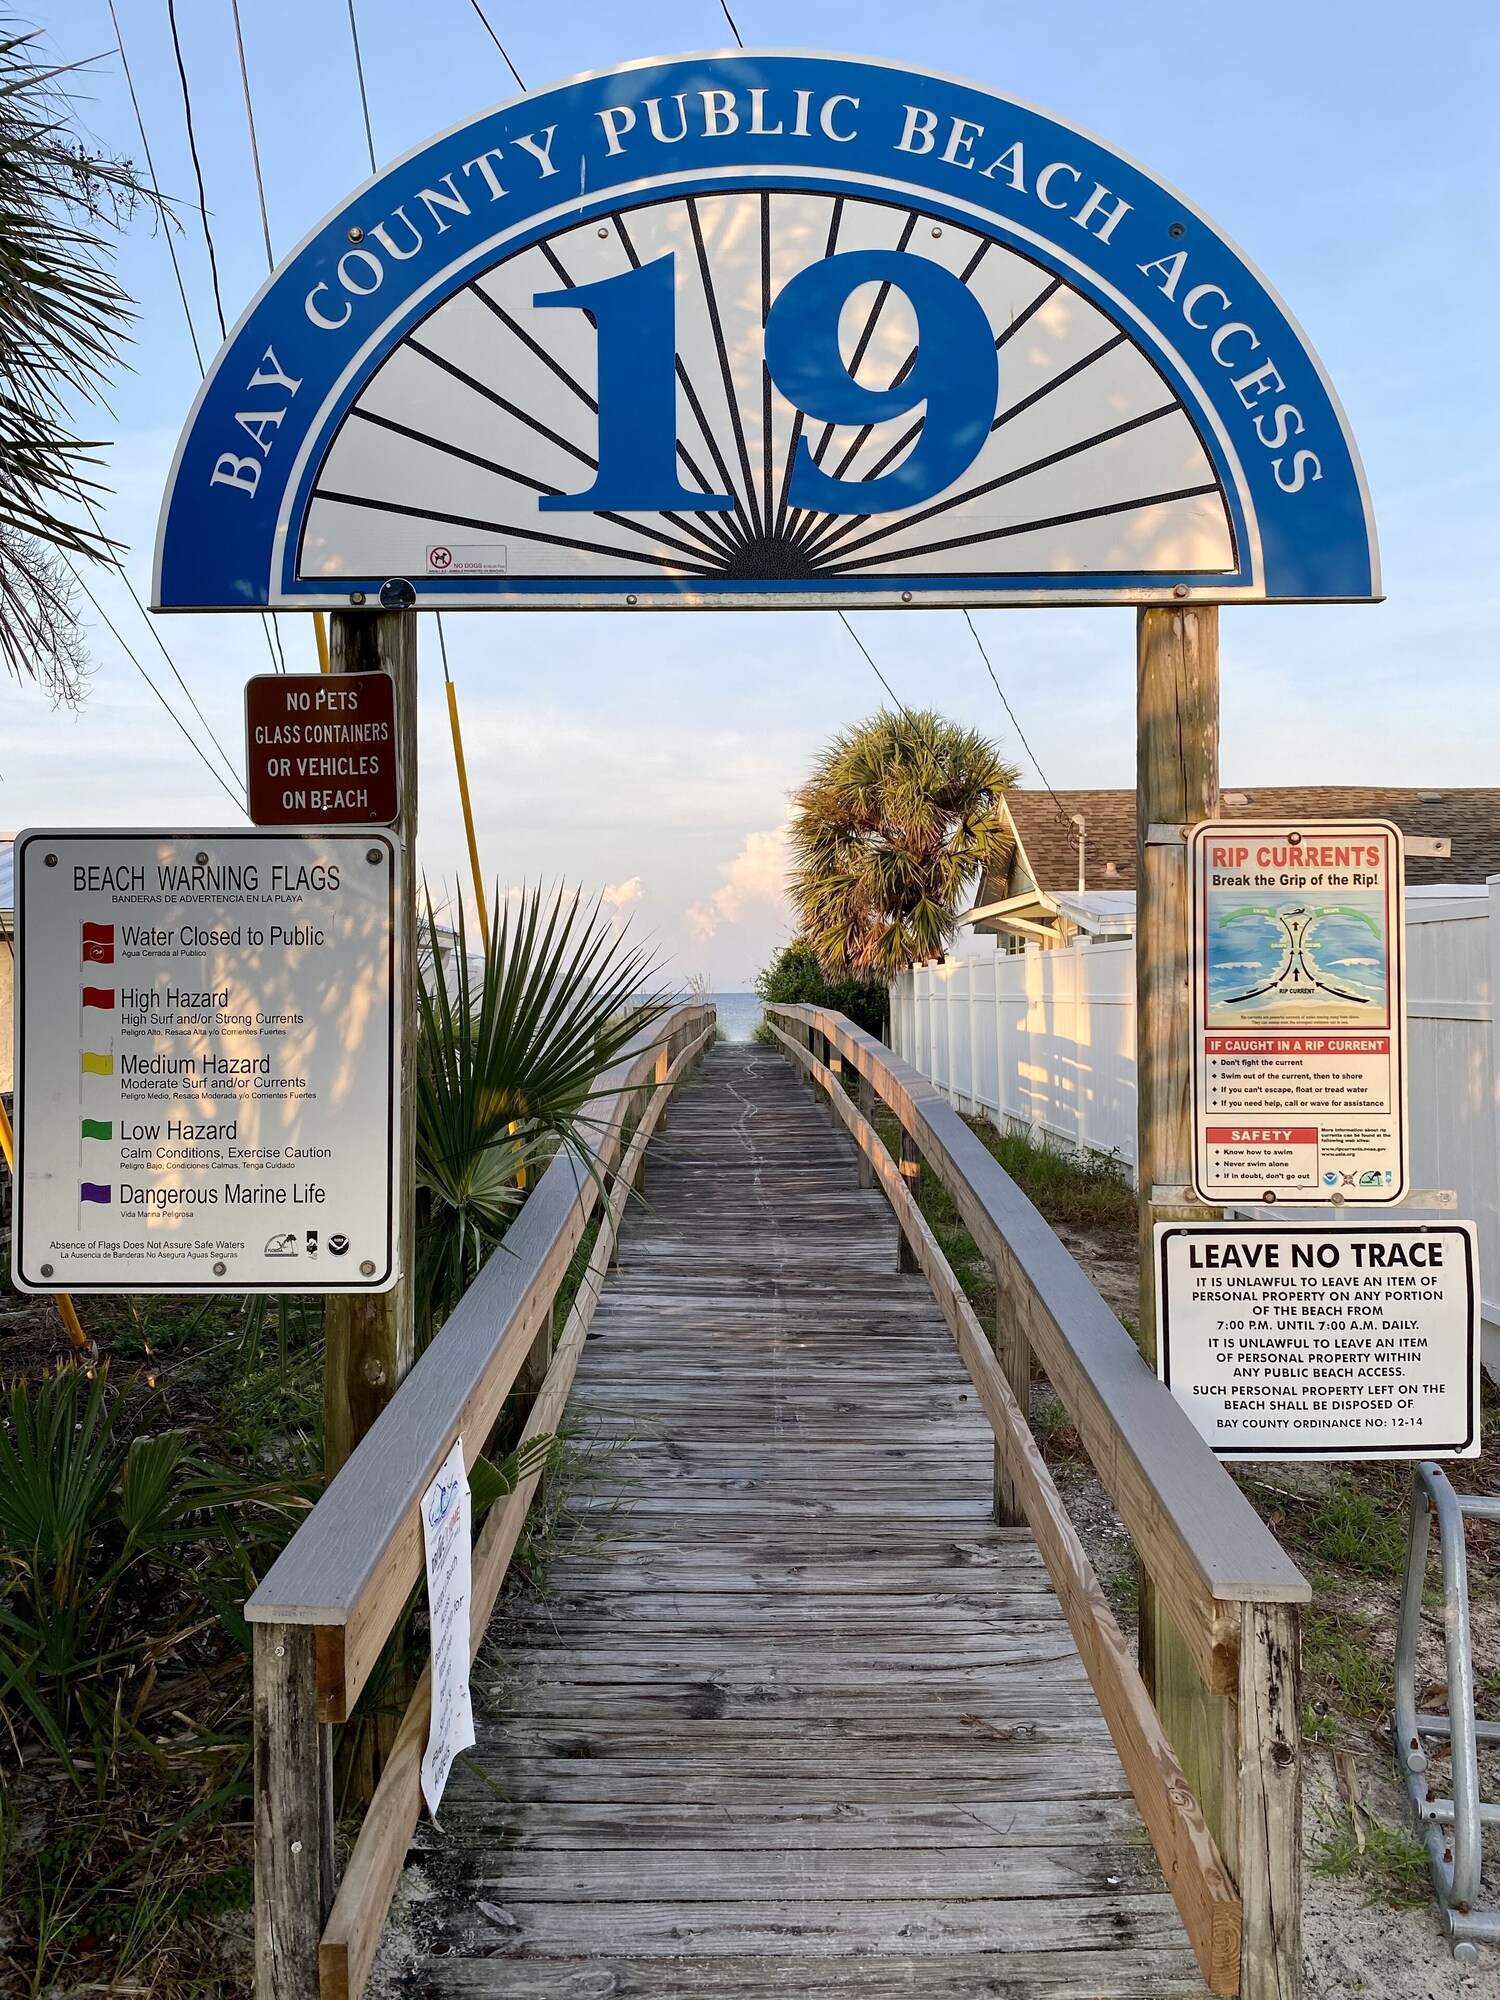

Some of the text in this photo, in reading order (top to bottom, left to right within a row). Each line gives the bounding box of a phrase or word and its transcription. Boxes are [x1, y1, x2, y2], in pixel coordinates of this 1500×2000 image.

[210, 88, 1323, 499] BAY COUNTY PUBLIC BEACH ACCESS
[532, 249, 999, 515] 19
[287, 692, 357, 710] NO PETS
[256, 723, 388, 744] GLASS CONTAINERS
[268, 756, 378, 776] OR VEHICLES
[283, 790, 367, 809] ON BEACH
[1213, 846, 1380, 867] RIP CURRENTS
[74, 866, 340, 891] BEACH WARNING FLAGS
[1213, 874, 1378, 888] Break the Grip of the Rip!
[112, 894, 304, 903] BANDERAS DE ADVERTENCIA EN LA PLAYA
[122, 926, 324, 946] Water Closed to Public
[121, 950, 140, 958] Agua
[142, 949, 170, 957] Cerrada
[180, 949, 207, 957] Publico
[122, 988, 228, 1011] High Hazard
[122, 1013, 303, 1027] High Surf and/or Strong Currents
[1211, 1040, 1384, 1051] IF CAUGHT IN A RIP CURRENT
[122, 1055, 269, 1074] Medium Hazard
[1242, 1059, 1259, 1068] fight
[1257, 1072, 1265, 1080] of
[1313, 1072, 1330, 1080] then
[1342, 1072, 1363, 1080] shore
[122, 1077, 306, 1089] Moderate Surf and/or Currents
[121, 1120, 236, 1140] Low Hazard
[1232, 1130, 1292, 1140] SAFETY
[121, 1147, 331, 1159] Calm Conditions, Exercise Caution
[121, 1184, 325, 1209] Dangerous Marine Life
[49, 1240, 245, 1251] Absence of Flags Does Not Assure Safe Waters
[1190, 1243, 1443, 1268] LEAVE NO TRACE
[1196, 1276, 1437, 1287] IT IS UNLAWFUL TO LEAVE AN ITEM OF
[1192, 1290, 1443, 1302] PERSONAL PROPERTY ON ANY PORTION
[1252, 1306, 1383, 1316] OF THE BEACH FROM
[1217, 1320, 1419, 1330] 7:00 P.M. UNTIL 7:00 A.M. DAILY.
[1216, 1352, 1421, 1363] OF PERSONAL PROPERTY WITHIN
[1233, 1367, 1405, 1378] ANY PUBLIC BEACH ACCESS.
[1193, 1384, 1445, 1396] SUCH PERSONAL PROPERTY LEFT ON THE
[1224, 1400, 1265, 1410] BEACH
[1270, 1400, 1309, 1410] SHALL
[1313, 1401, 1327, 1410] BE
[1332, 1400, 1393, 1410] DISPOSED
[1217, 1418, 1422, 1428] BAY COUNTY ORDINANCE NO: 12-14
